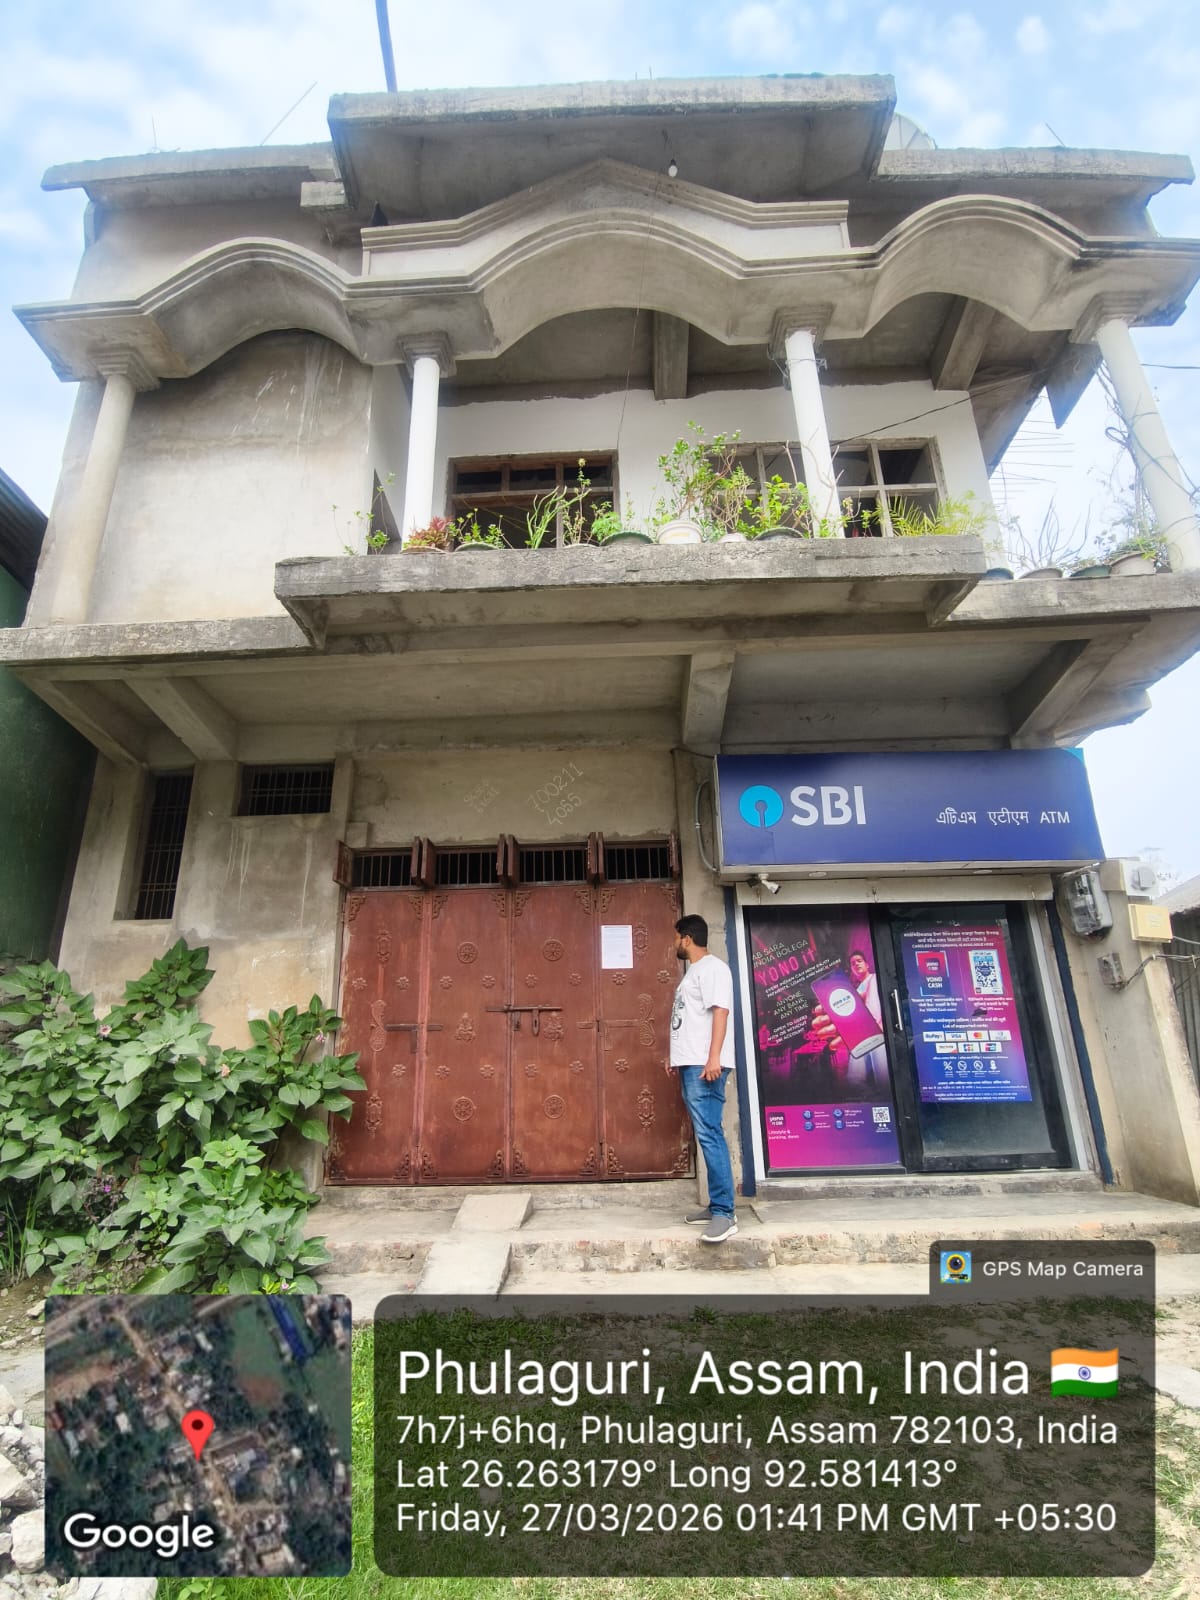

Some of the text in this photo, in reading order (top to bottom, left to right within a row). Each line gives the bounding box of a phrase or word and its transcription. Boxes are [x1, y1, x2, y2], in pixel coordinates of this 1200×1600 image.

[790, 785, 867, 827] SBI
[936, 807, 1071, 826] এটিএম एटीएम ATM
[753, 939, 809, 969] INDIA BOLEGA
[763, 942, 785, 956] SARA
[757, 956, 799, 986] YONO
[774, 1005, 786, 1016] ANY
[780, 1002, 808, 1020] ANY TIME
